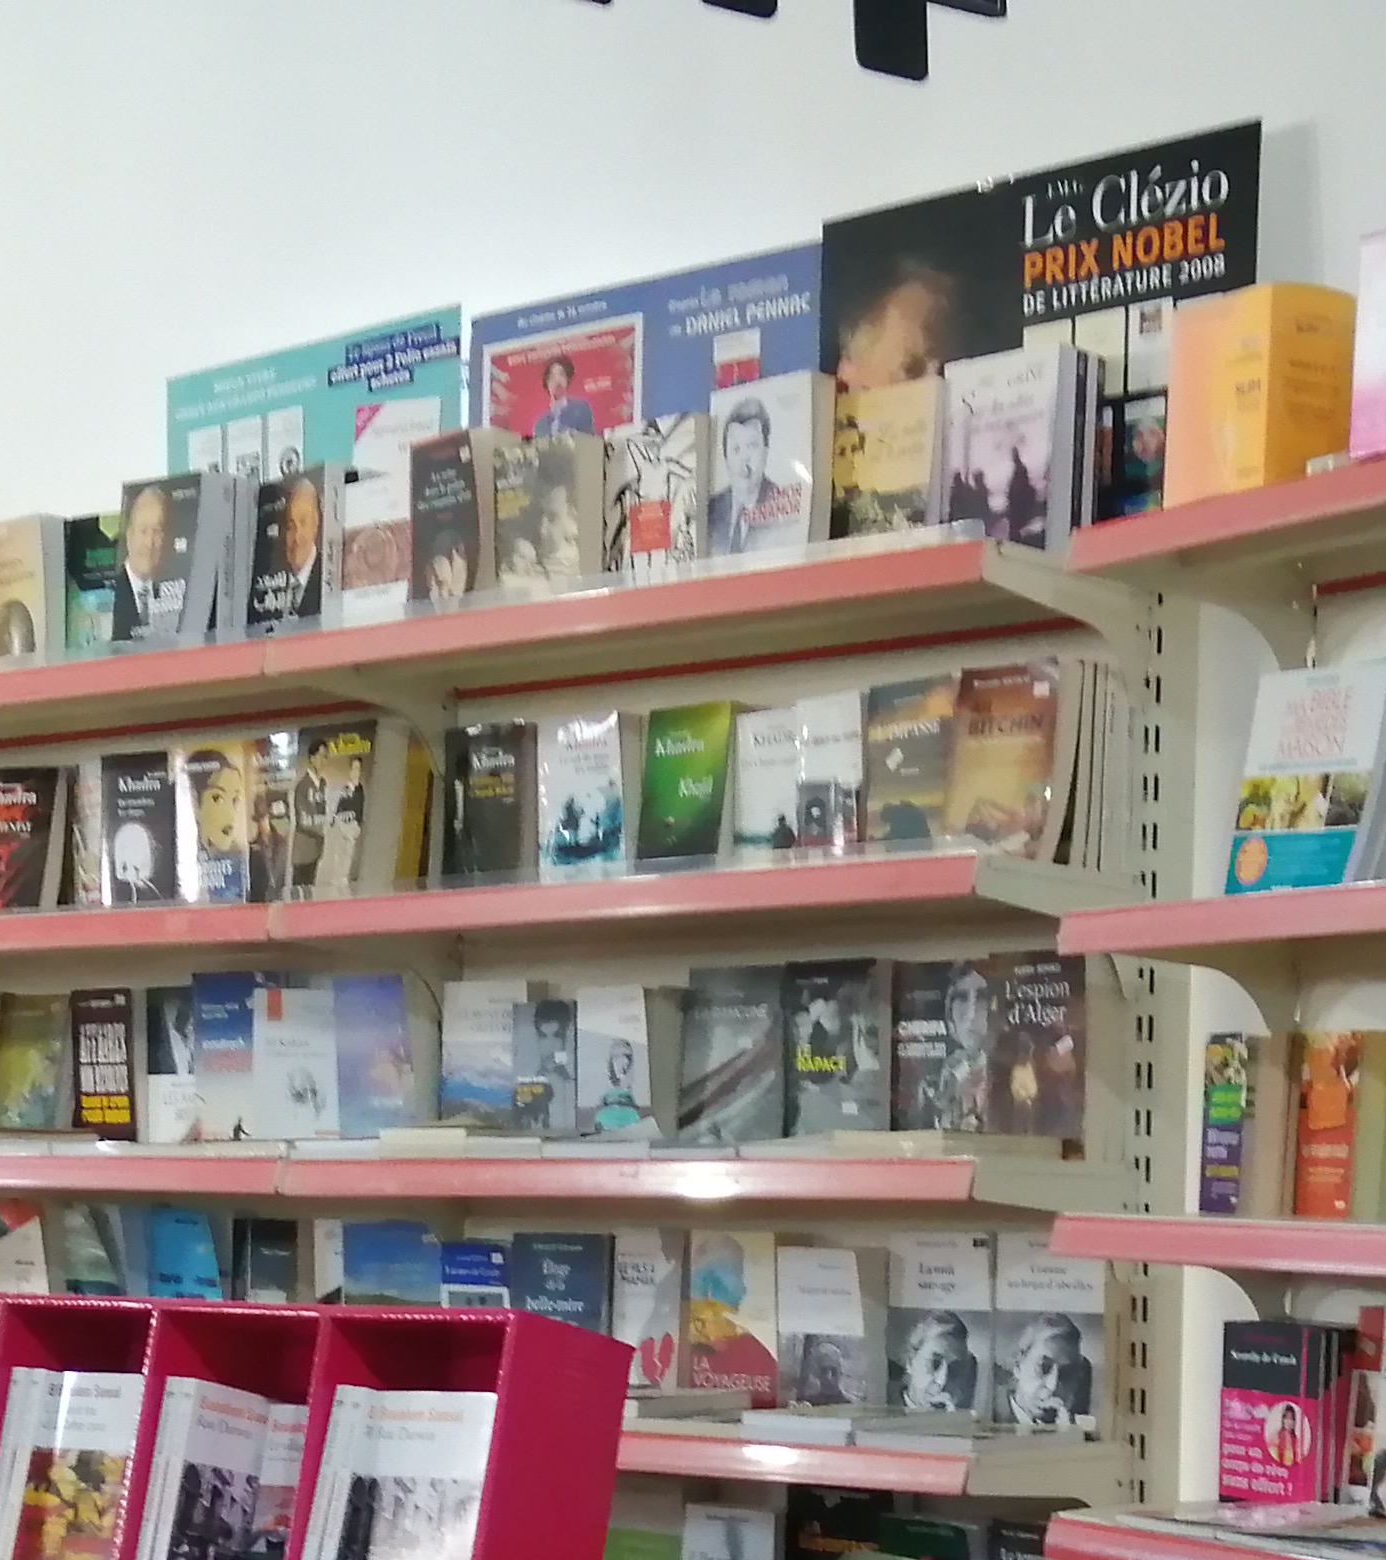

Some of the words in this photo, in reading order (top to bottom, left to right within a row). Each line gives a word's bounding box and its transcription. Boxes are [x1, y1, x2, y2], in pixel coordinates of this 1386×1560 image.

[1021, 194, 1077, 249] Le
[1091, 158, 1230, 234] Clézio
[1023, 237, 1100, 289] PRIX
[1112, 211, 1226, 271] NOBEL
[685, 306, 742, 337] DANIEL
[745, 290, 812, 326] PENNAC
[1022, 289, 1046, 317] DE
[1004, 976, 1071, 1001] L'espion
[1008, 1000, 1069, 1027] d'Alger
[693, 1354, 710, 1371] LA
[693, 1371, 771, 1392] VOYAGEUSE
